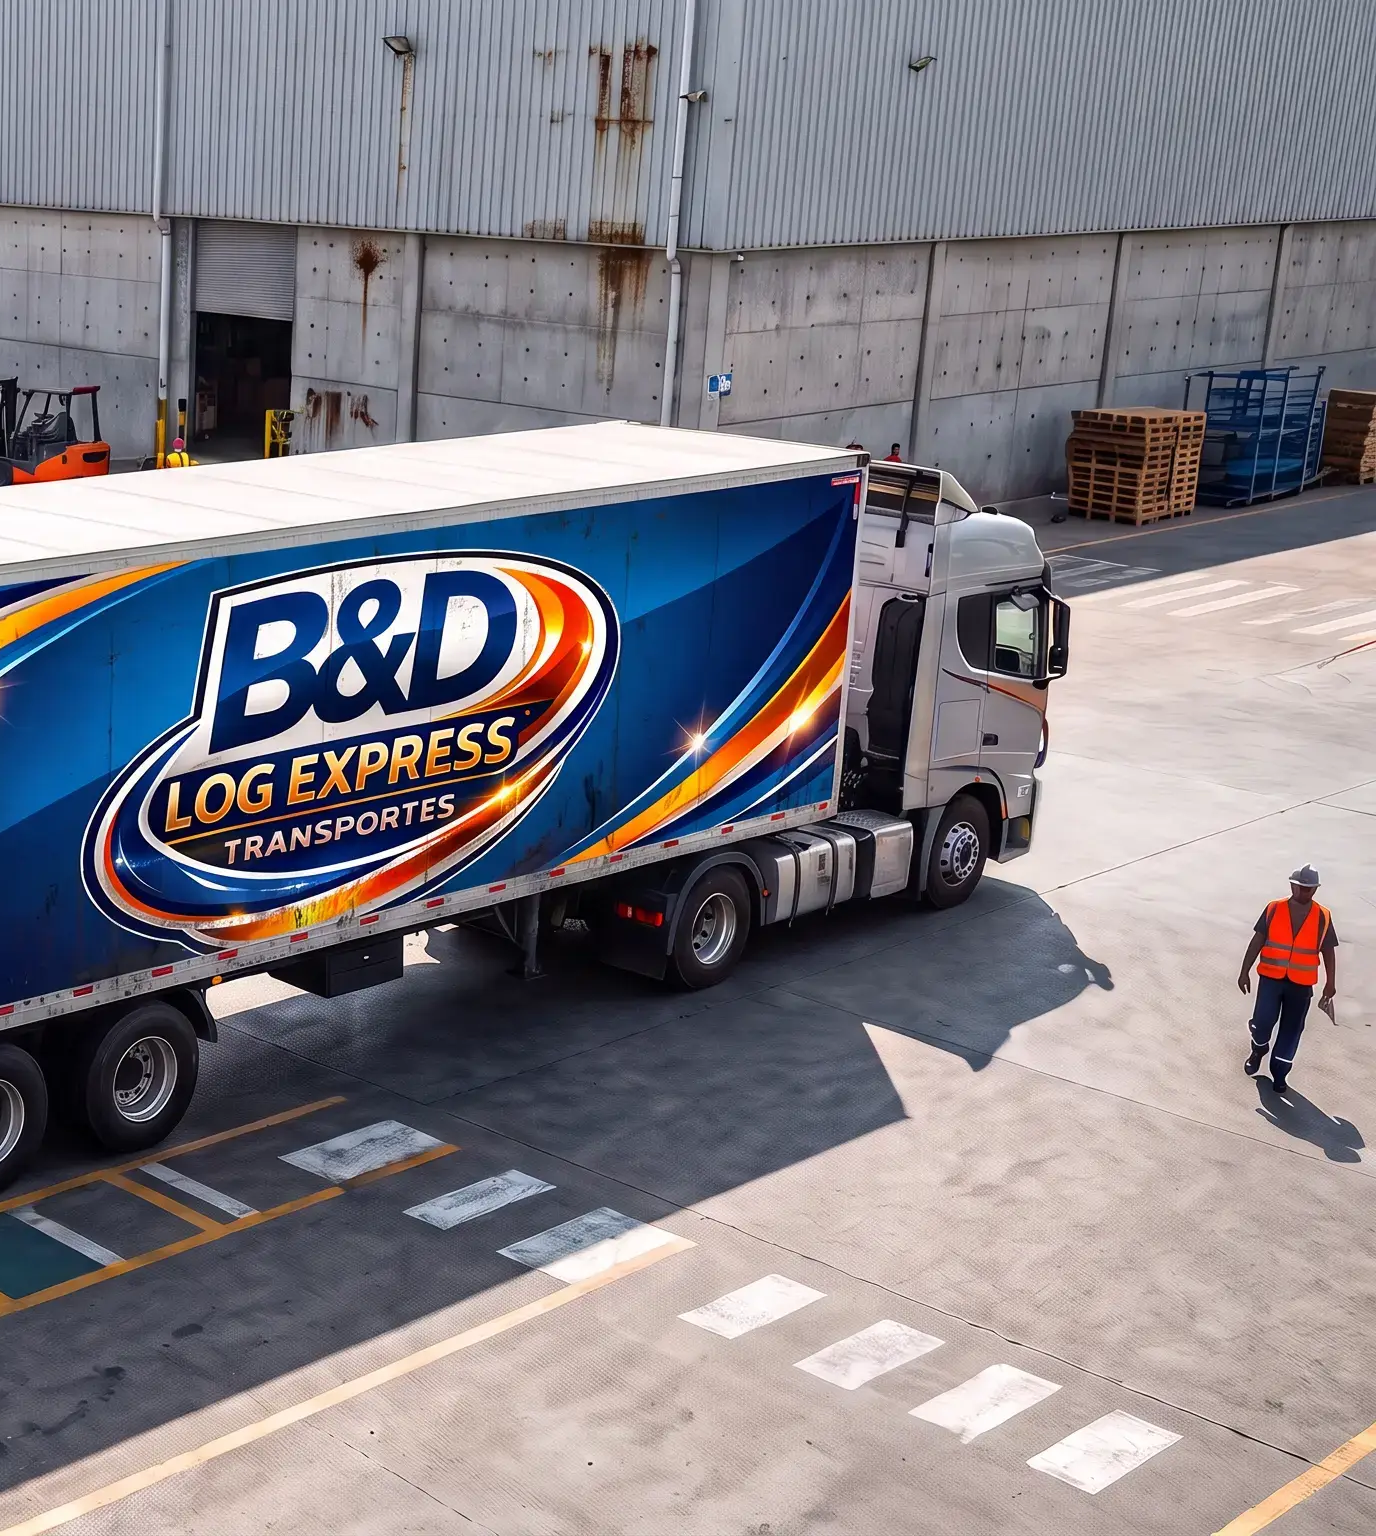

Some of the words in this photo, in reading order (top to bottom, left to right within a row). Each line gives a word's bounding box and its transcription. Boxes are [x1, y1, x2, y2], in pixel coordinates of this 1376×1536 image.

[208, 570, 518, 755] B&D
[164, 762, 276, 832] LOG
[287, 716, 516, 806] EXPRESS
[224, 793, 456, 866] TRANSPORTES
